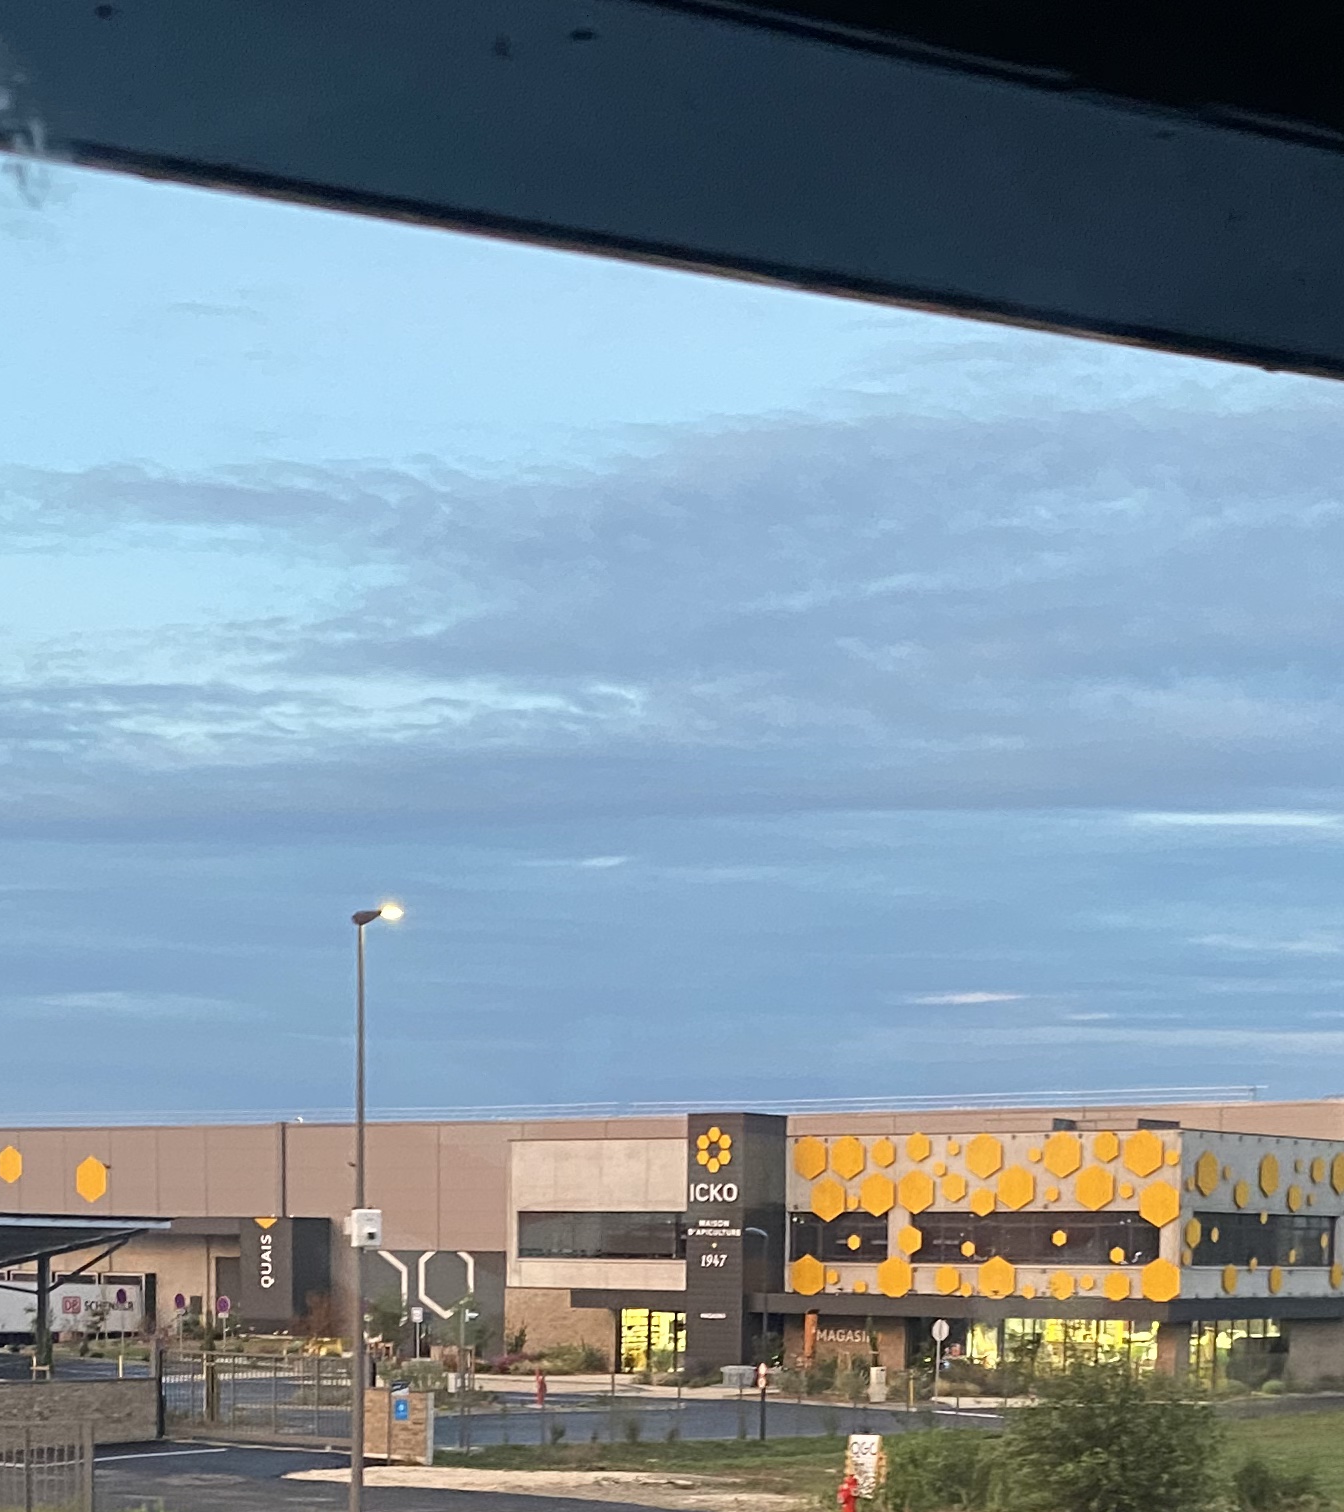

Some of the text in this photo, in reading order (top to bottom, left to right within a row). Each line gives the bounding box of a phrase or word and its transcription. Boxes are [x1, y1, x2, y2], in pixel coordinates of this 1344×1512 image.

[689, 1183, 738, 1203] ICKO
[260, 1234, 275, 1289] QUAIS
[700, 1254, 727, 1267] 1947
